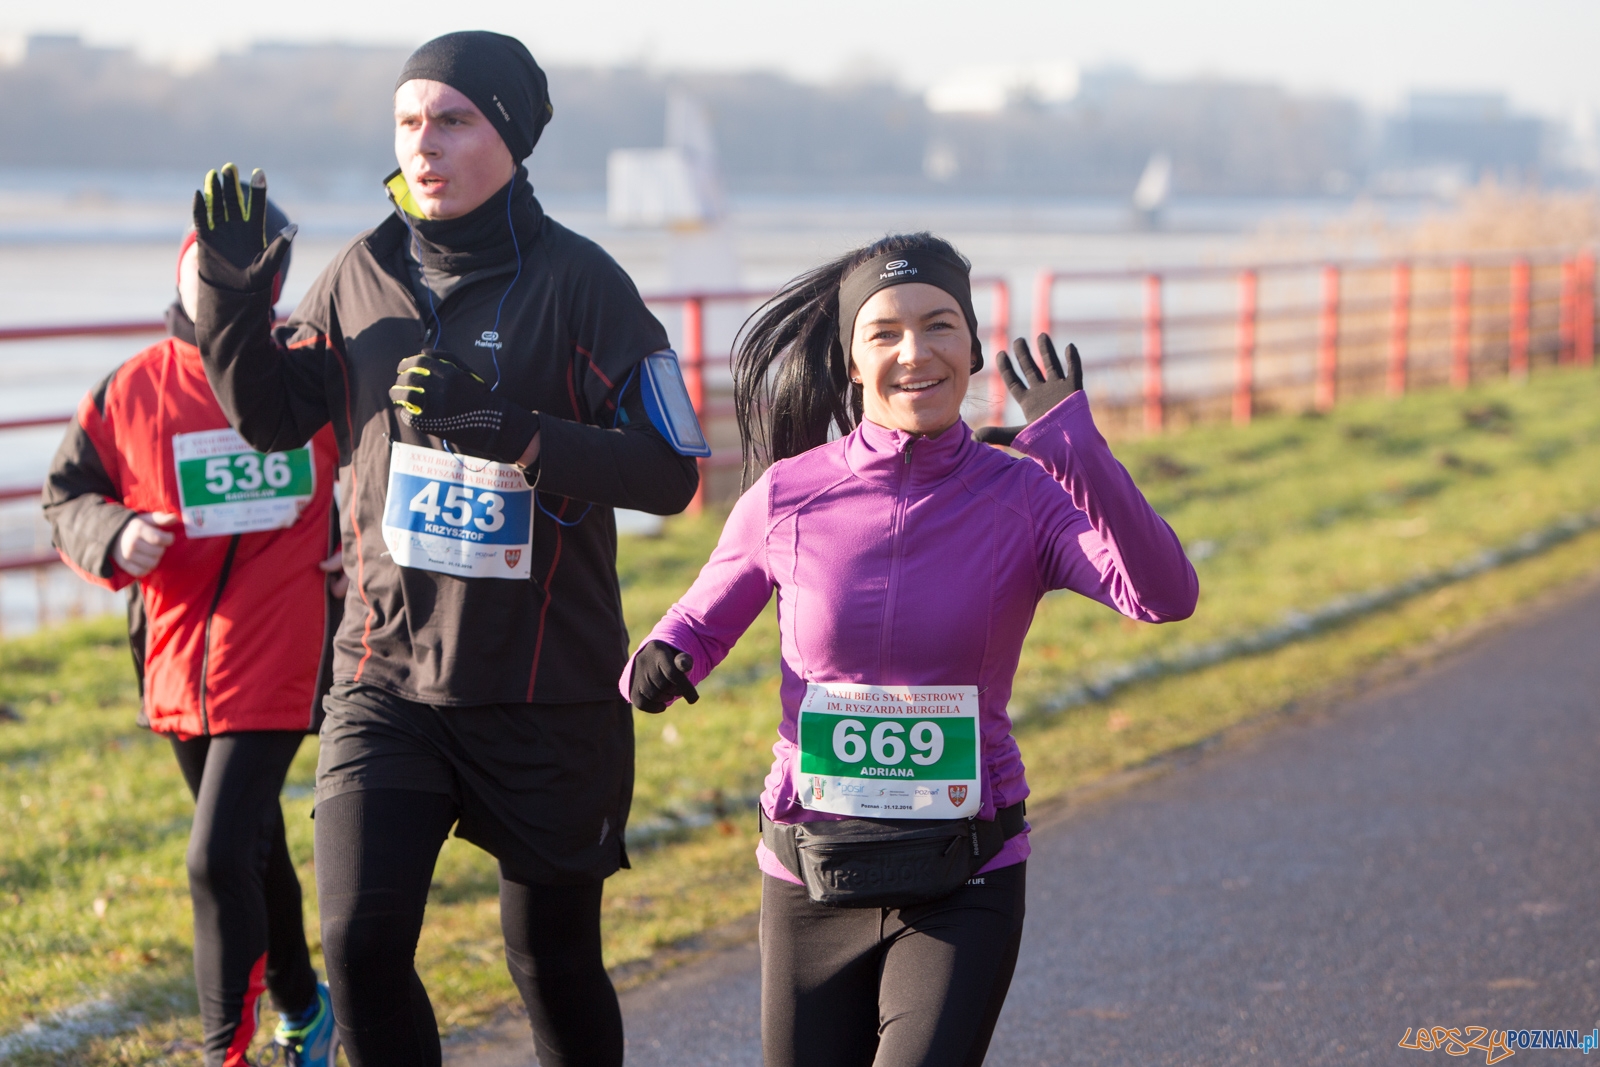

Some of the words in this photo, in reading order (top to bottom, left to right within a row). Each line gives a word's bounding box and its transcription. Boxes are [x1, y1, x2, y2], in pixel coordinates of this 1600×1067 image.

[879, 268, 917, 279] Kalenji
[409, 452, 434, 466] XXXII
[435, 455, 457, 469] BIEG
[205, 452, 292, 495] 536
[426, 467, 475, 482] RYSZARDA
[475, 475, 523, 489] BURGIELA
[409, 481, 504, 532] 453
[425, 523, 484, 541] KRZYSZTOF
[824, 690, 852, 700] XXXII
[854, 692, 880, 702] BIEG
[882, 692, 965, 703] SYLWESTROWY
[827, 702, 843, 711] IM.
[845, 703, 904, 714] RYSZARDA
[906, 705, 961, 715] BURGIELA
[832, 718, 945, 766] 669
[860, 766, 915, 777] ADRIANA
[972, 877, 985, 885] LIFE
